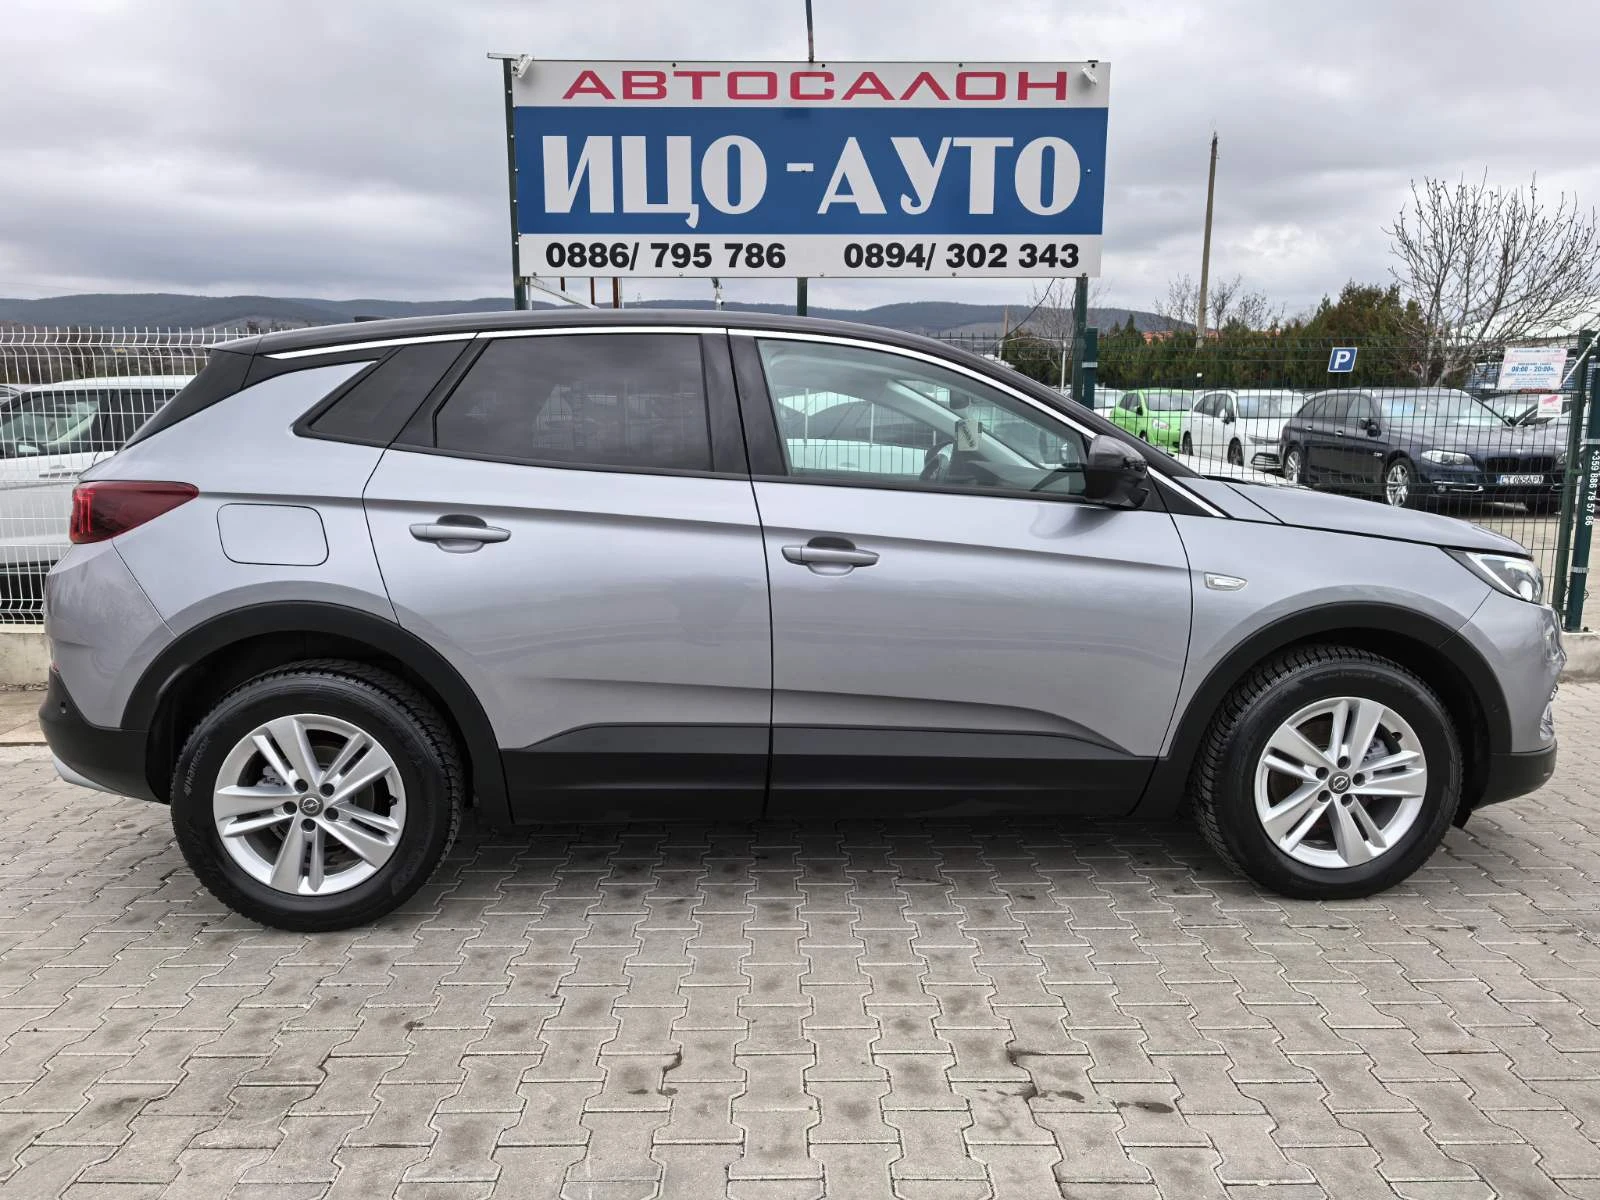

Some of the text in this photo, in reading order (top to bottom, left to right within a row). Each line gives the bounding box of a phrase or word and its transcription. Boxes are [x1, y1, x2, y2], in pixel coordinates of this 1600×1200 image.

[564, 70, 1067, 101] АВТОСАЛОН
[545, 242, 1079, 271] 0886/ 795 786 0894/ 302 343
[1334, 350, 1351, 369] P
[1588, 473, 1599, 489] 886
[1587, 490, 1597, 501] 79
[1586, 503, 1596, 513] 57
[1584, 515, 1595, 527] 86
